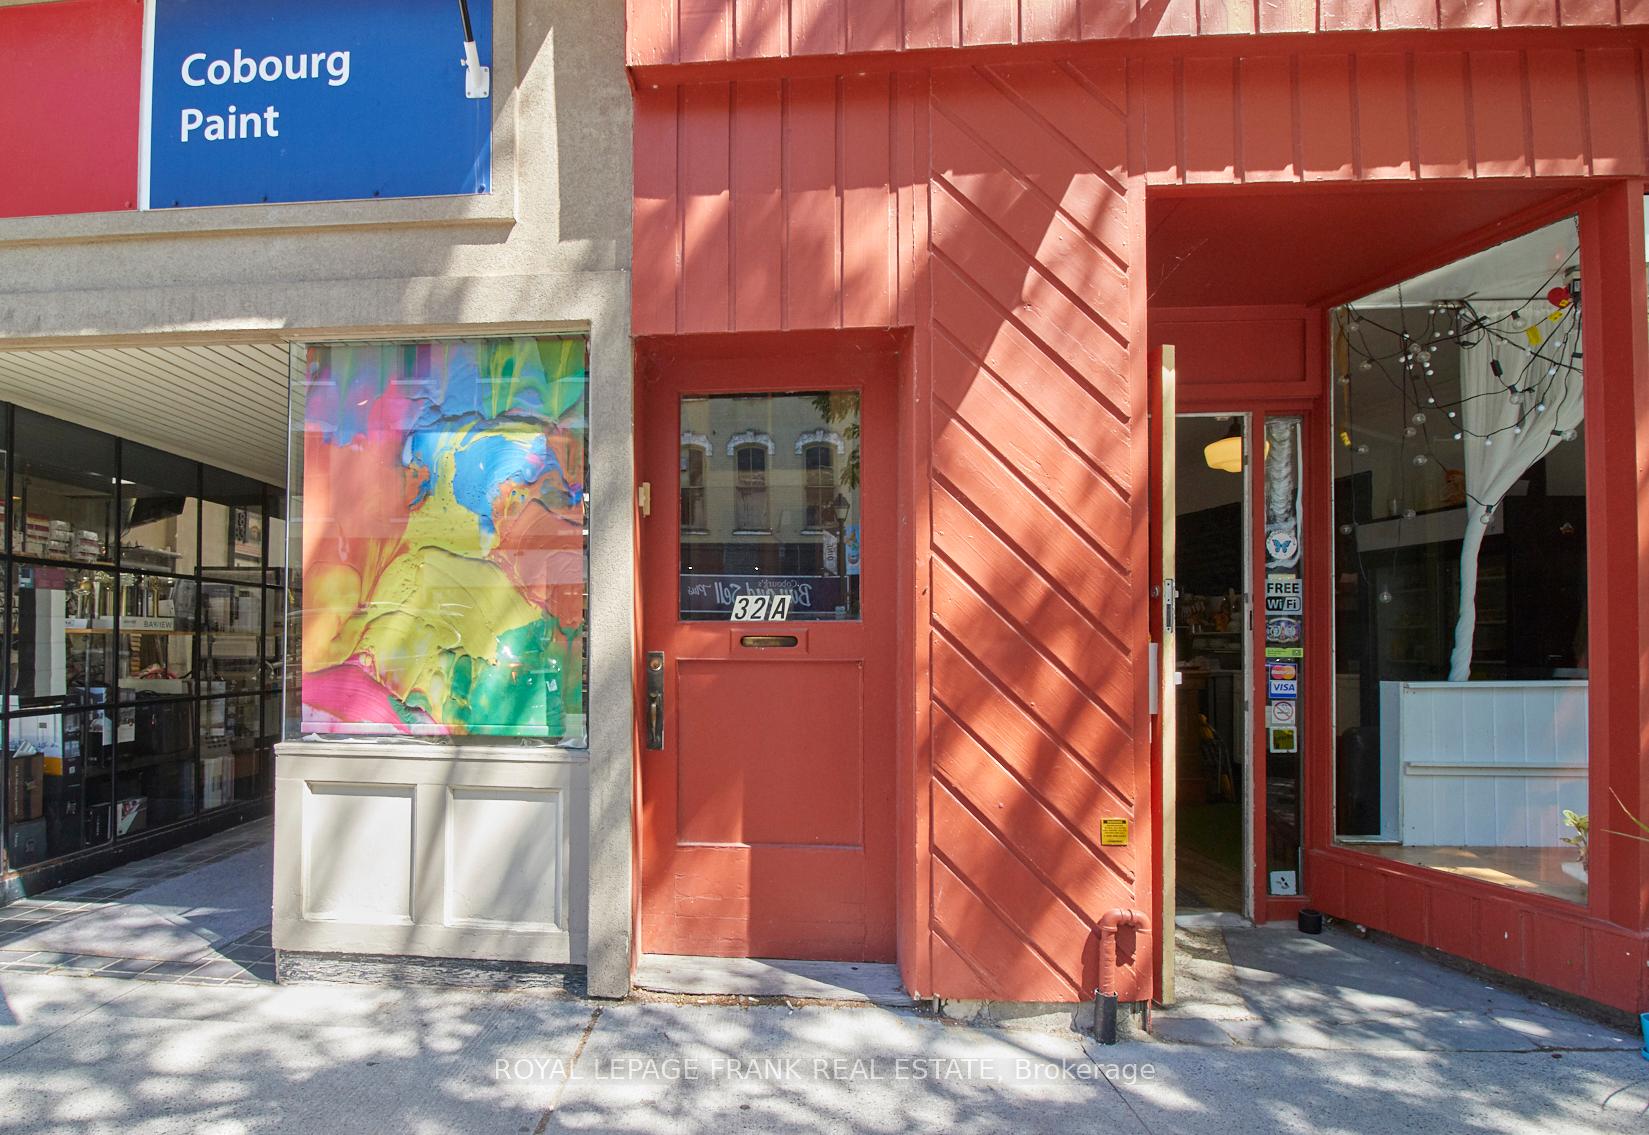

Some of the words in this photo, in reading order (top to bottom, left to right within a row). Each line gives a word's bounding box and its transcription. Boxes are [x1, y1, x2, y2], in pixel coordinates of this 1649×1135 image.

[181, 48, 351, 87] Cobourg
[181, 105, 280, 142] Paint
[1266, 582, 1300, 594] FREE
[1273, 683, 1295, 691] VISA
